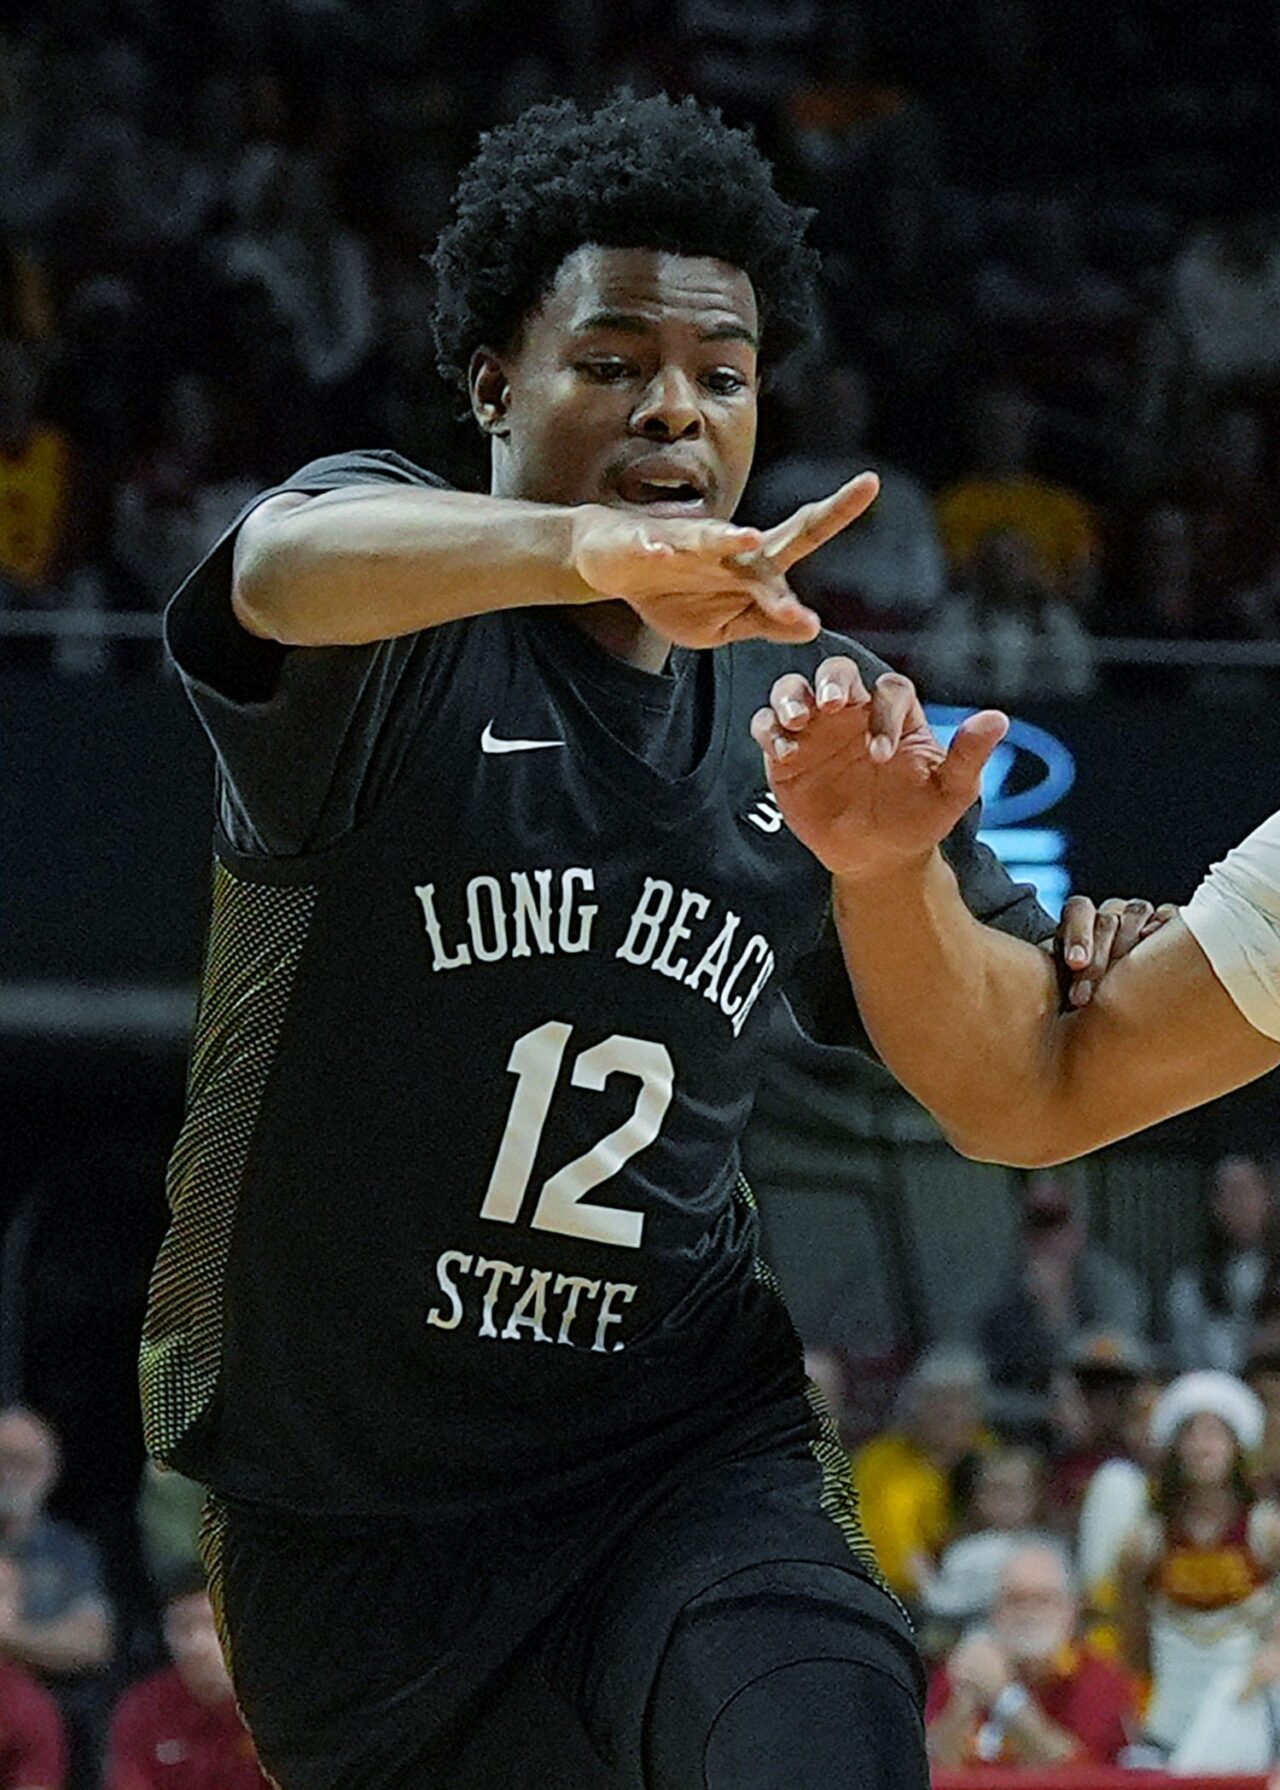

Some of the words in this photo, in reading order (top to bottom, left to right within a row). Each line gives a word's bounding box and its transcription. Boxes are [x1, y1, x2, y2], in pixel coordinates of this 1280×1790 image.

[414, 867, 599, 972] LONG
[479, 1020, 675, 1249] 12
[426, 1249, 639, 1353] STATE
